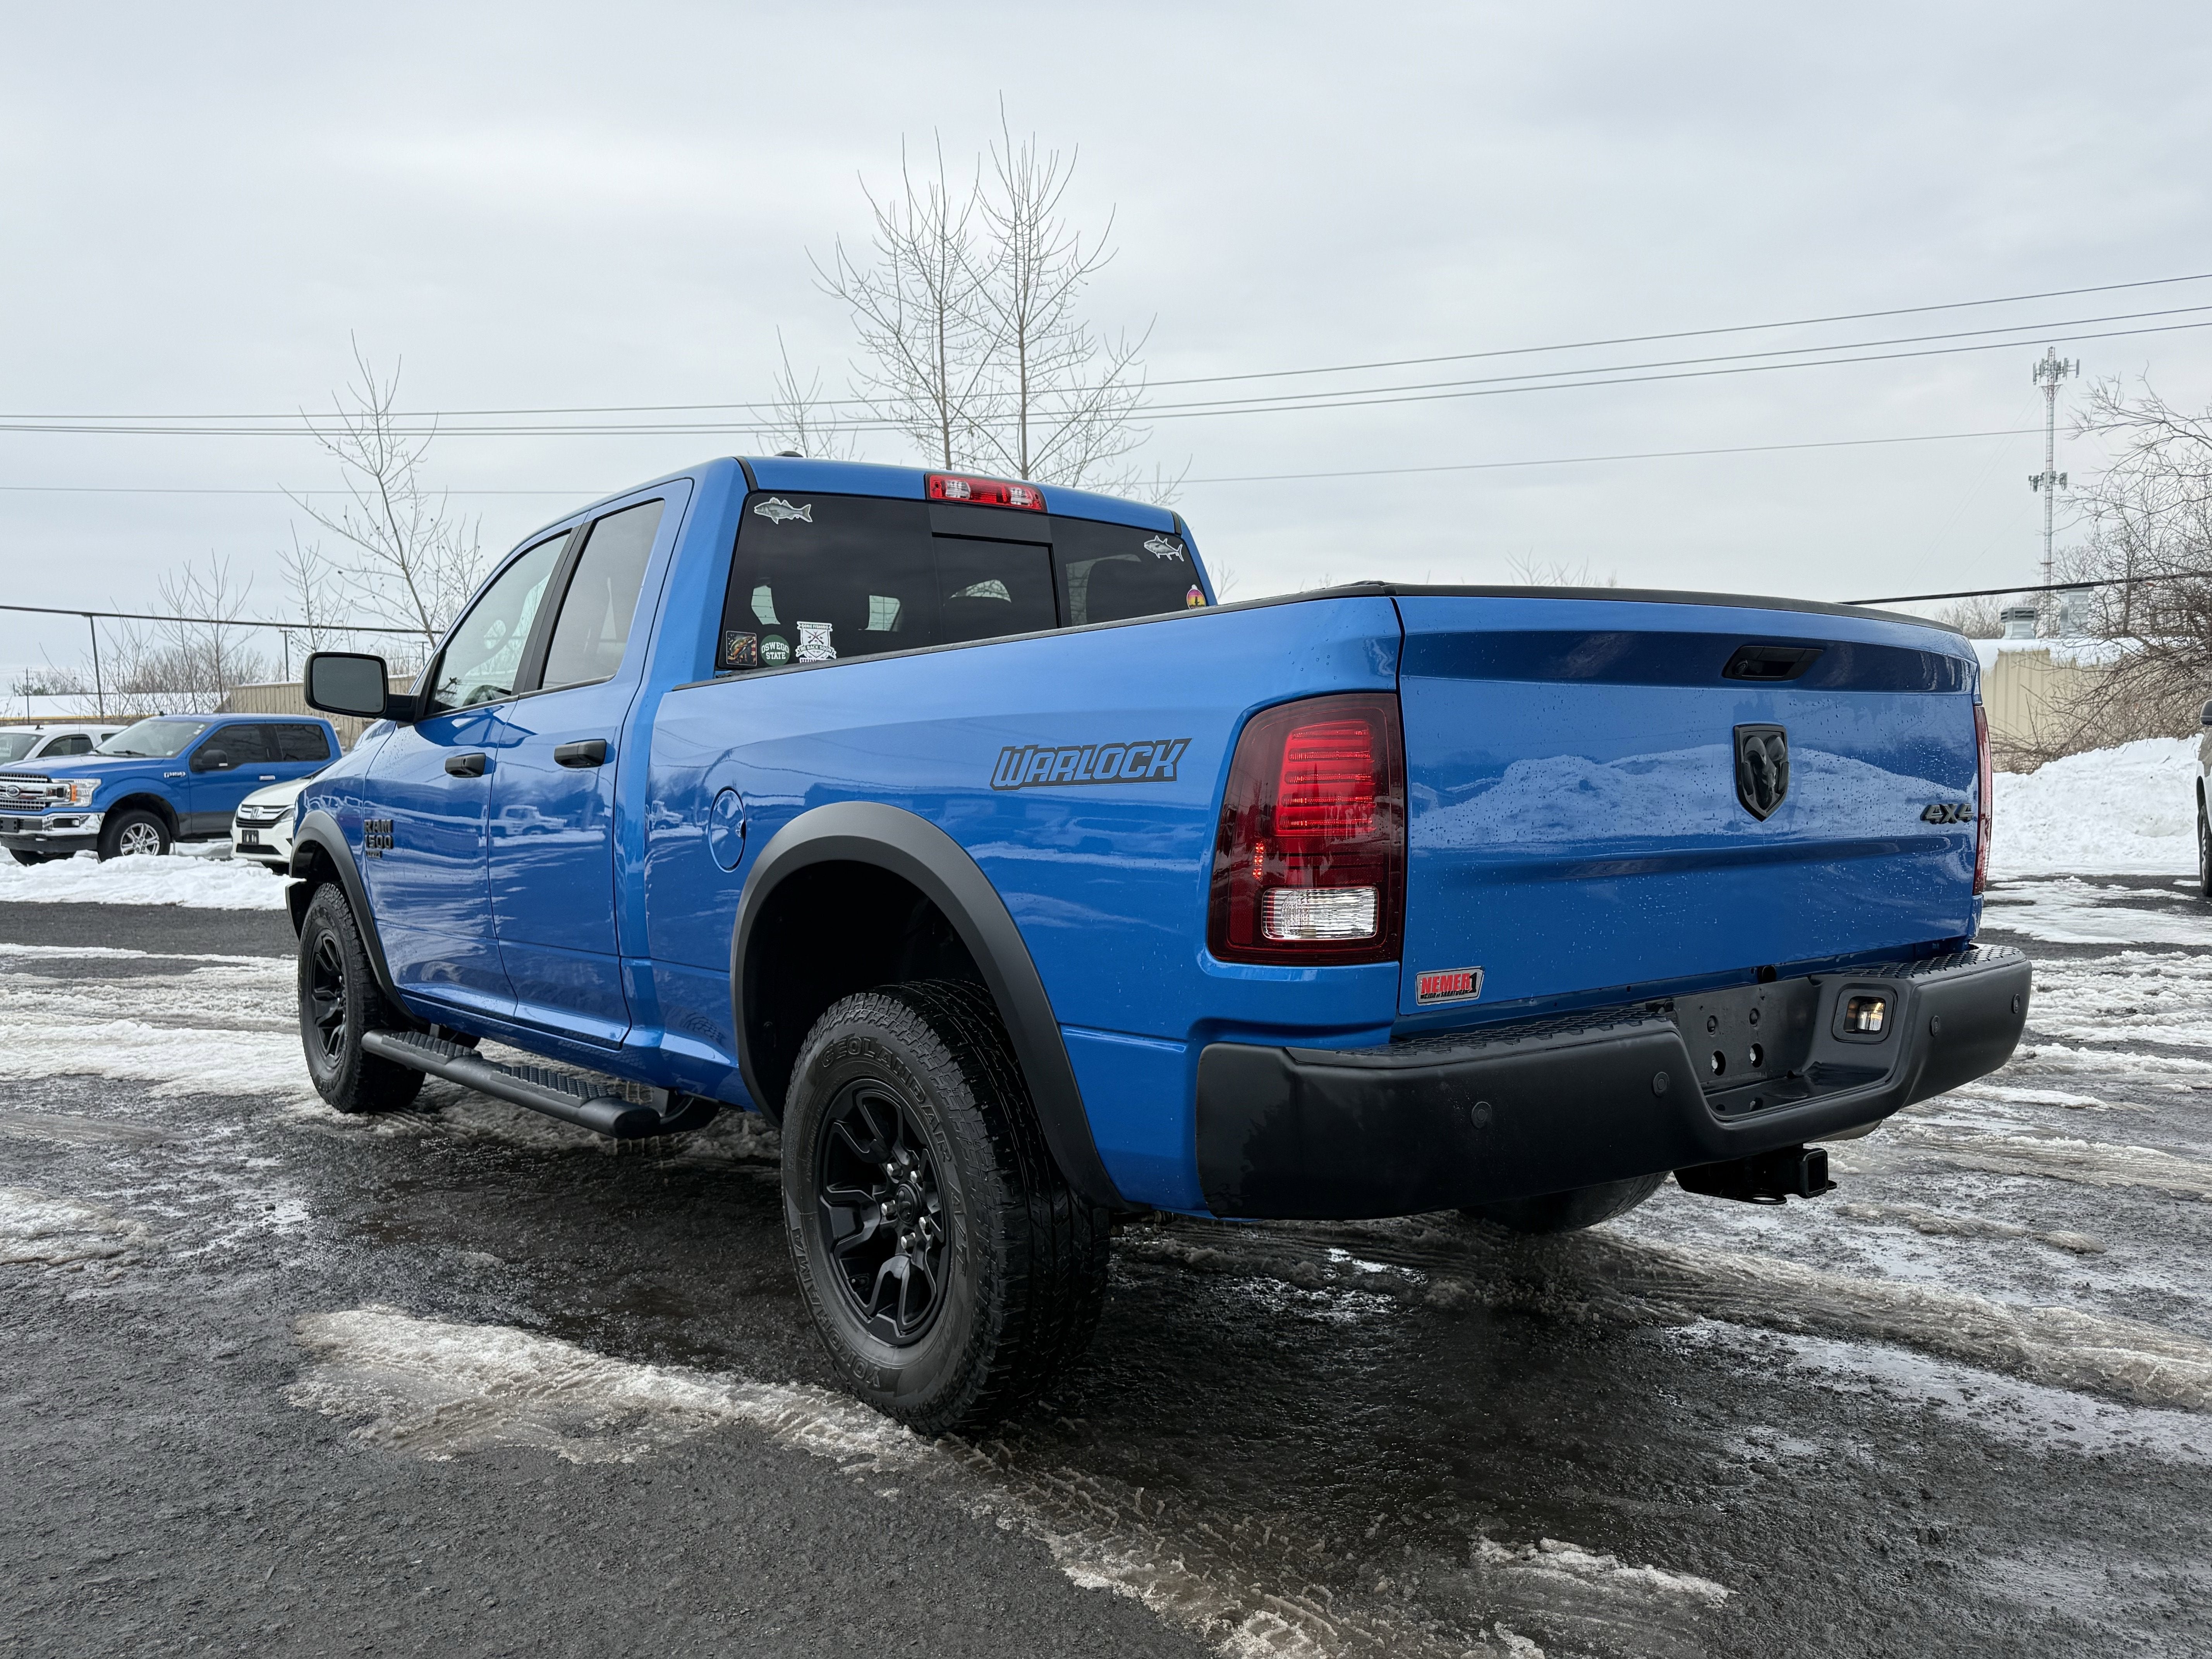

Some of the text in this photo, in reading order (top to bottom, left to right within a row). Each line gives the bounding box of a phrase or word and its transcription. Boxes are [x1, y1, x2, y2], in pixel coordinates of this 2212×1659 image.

[761, 642, 789, 654] OSWEGO
[989, 737, 1192, 791] WARLOCK
[364, 819, 393, 833] RAM
[365, 835, 394, 849] 1500
[1421, 973, 1470, 994] NEMER
[822, 1036, 952, 1163] GEOLANDAR
[792, 1228, 881, 1388] YOKOHAMA
